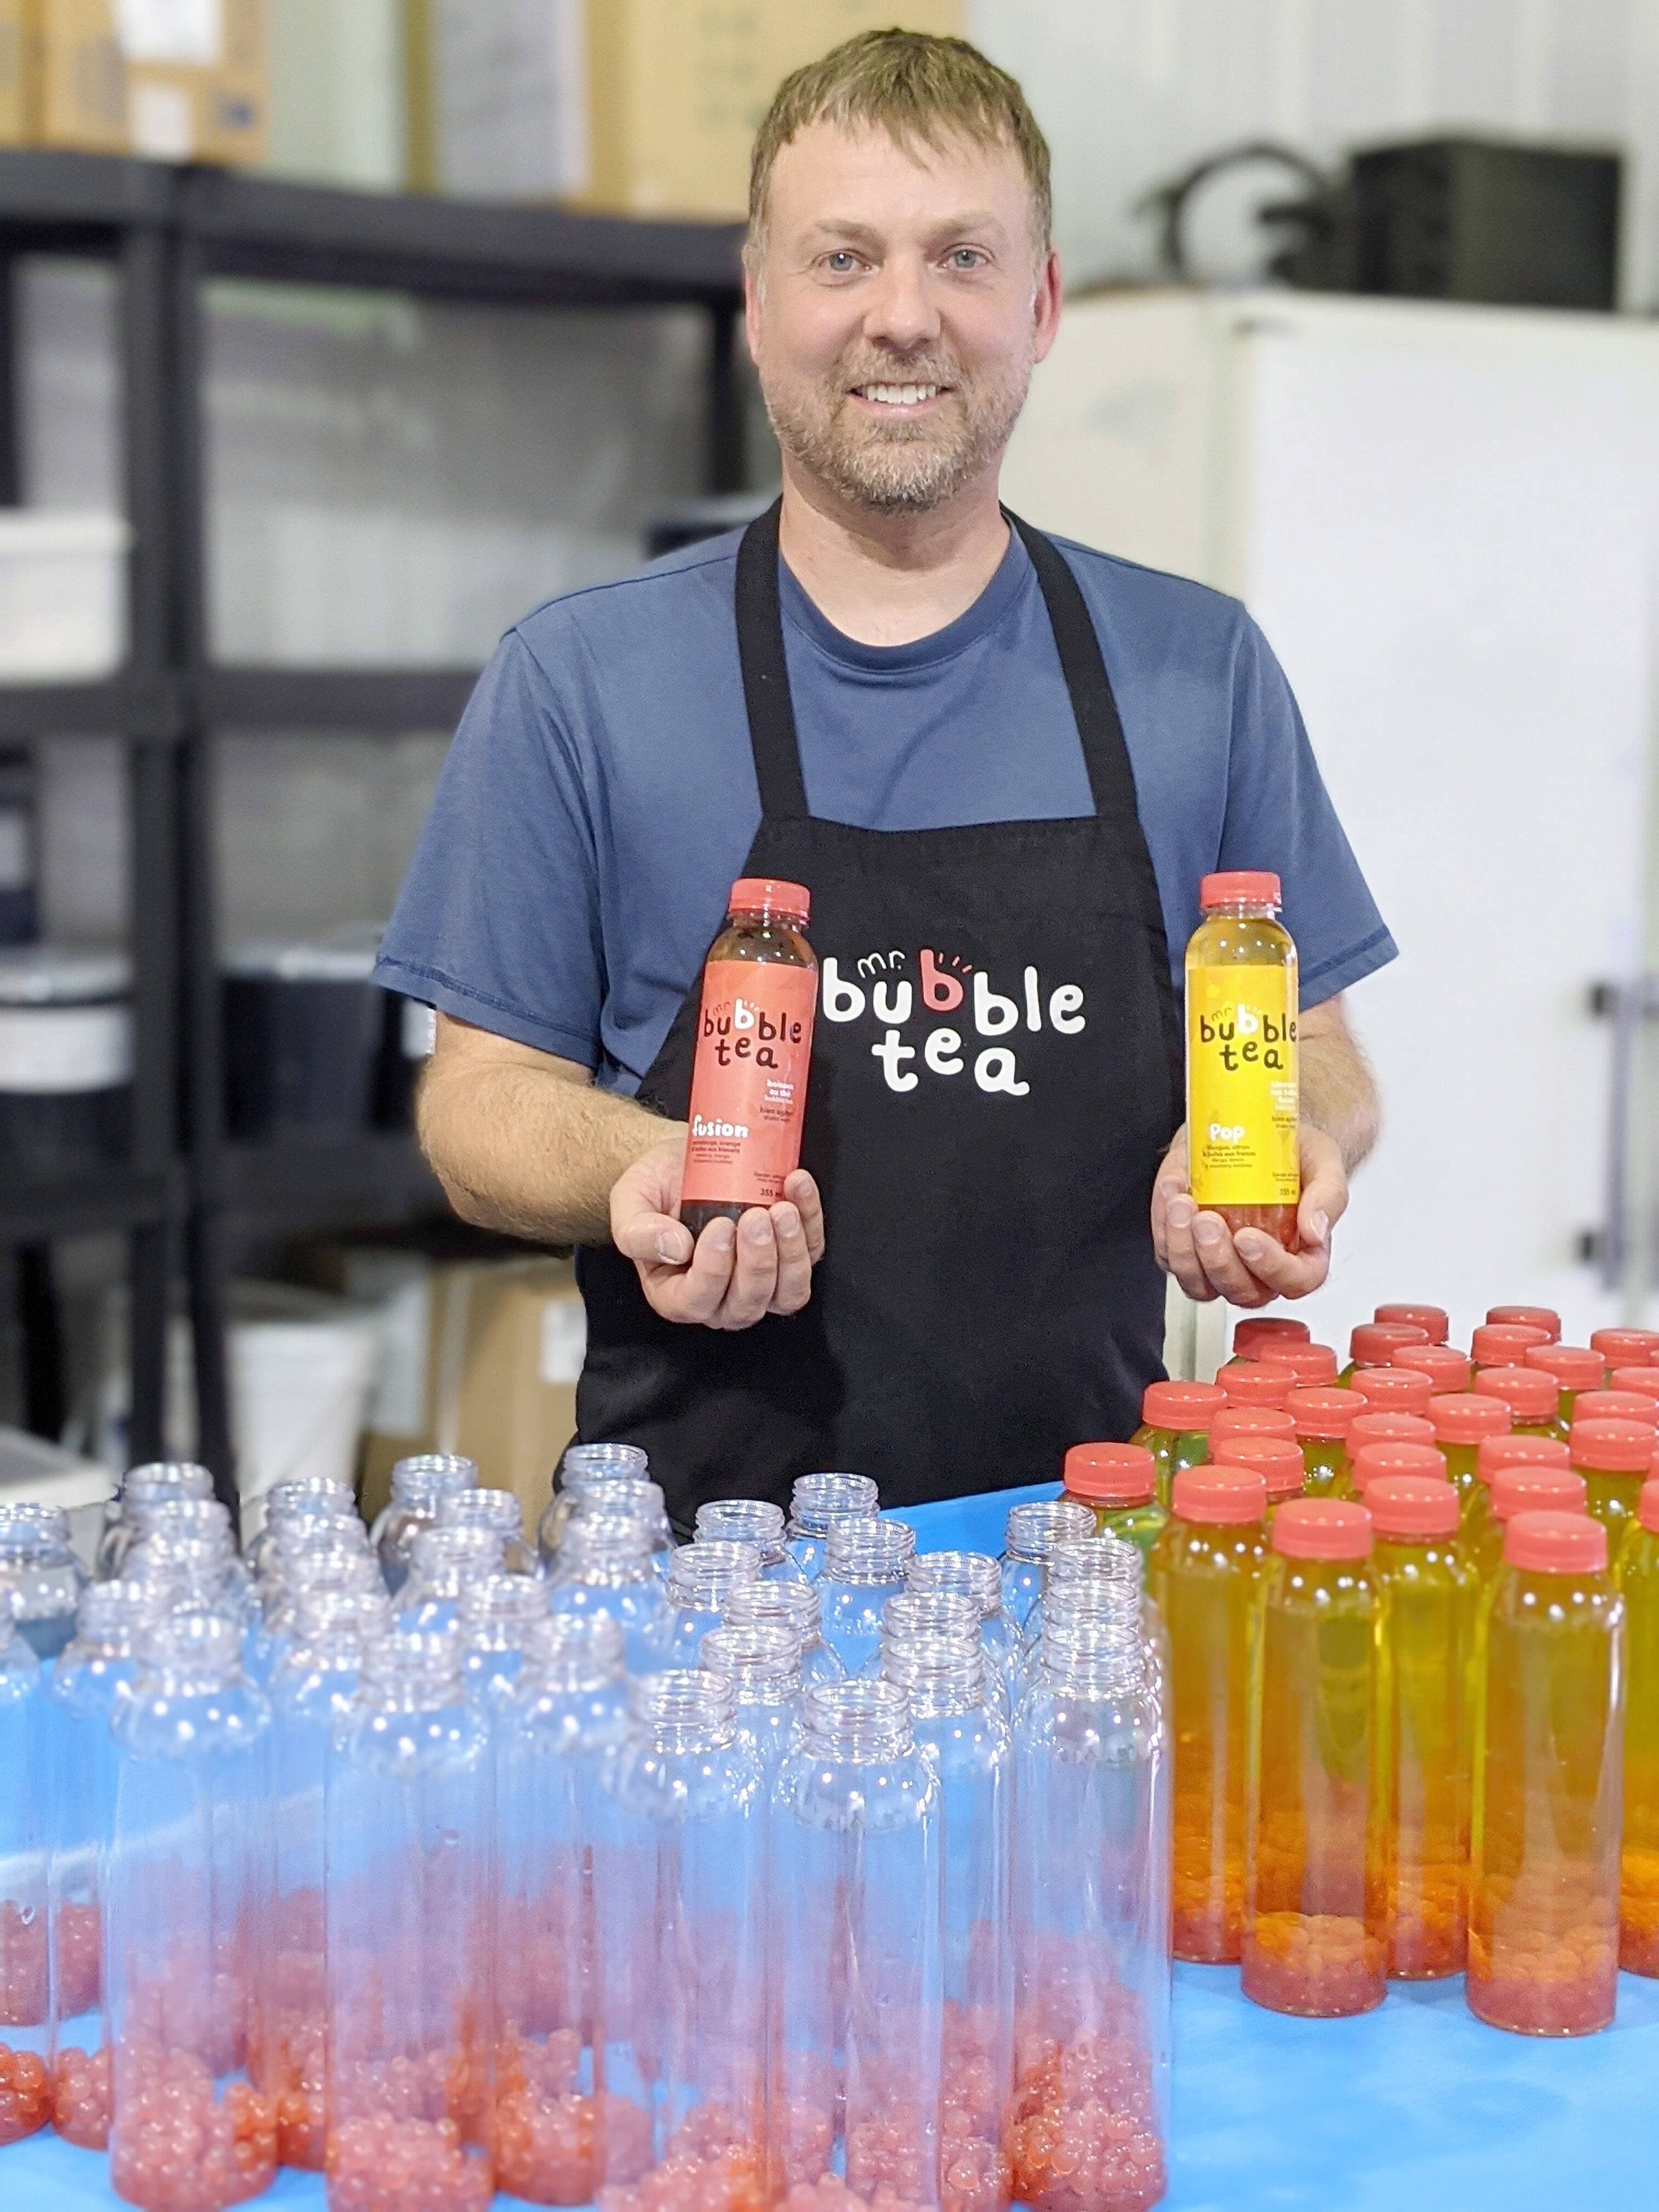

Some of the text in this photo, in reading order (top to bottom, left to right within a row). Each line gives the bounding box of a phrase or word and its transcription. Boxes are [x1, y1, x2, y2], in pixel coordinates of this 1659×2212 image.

[822, 948, 1086, 1036] bubble
[703, 998, 802, 1044] bubble
[1200, 1003, 1296, 1043] bubble
[714, 1038, 778, 1069] tea
[871, 1027, 1030, 1096] tea
[1218, 1041, 1284, 1071] tea
[692, 1114, 748, 1138] fusion
[1210, 1123, 1245, 1145] Pop
